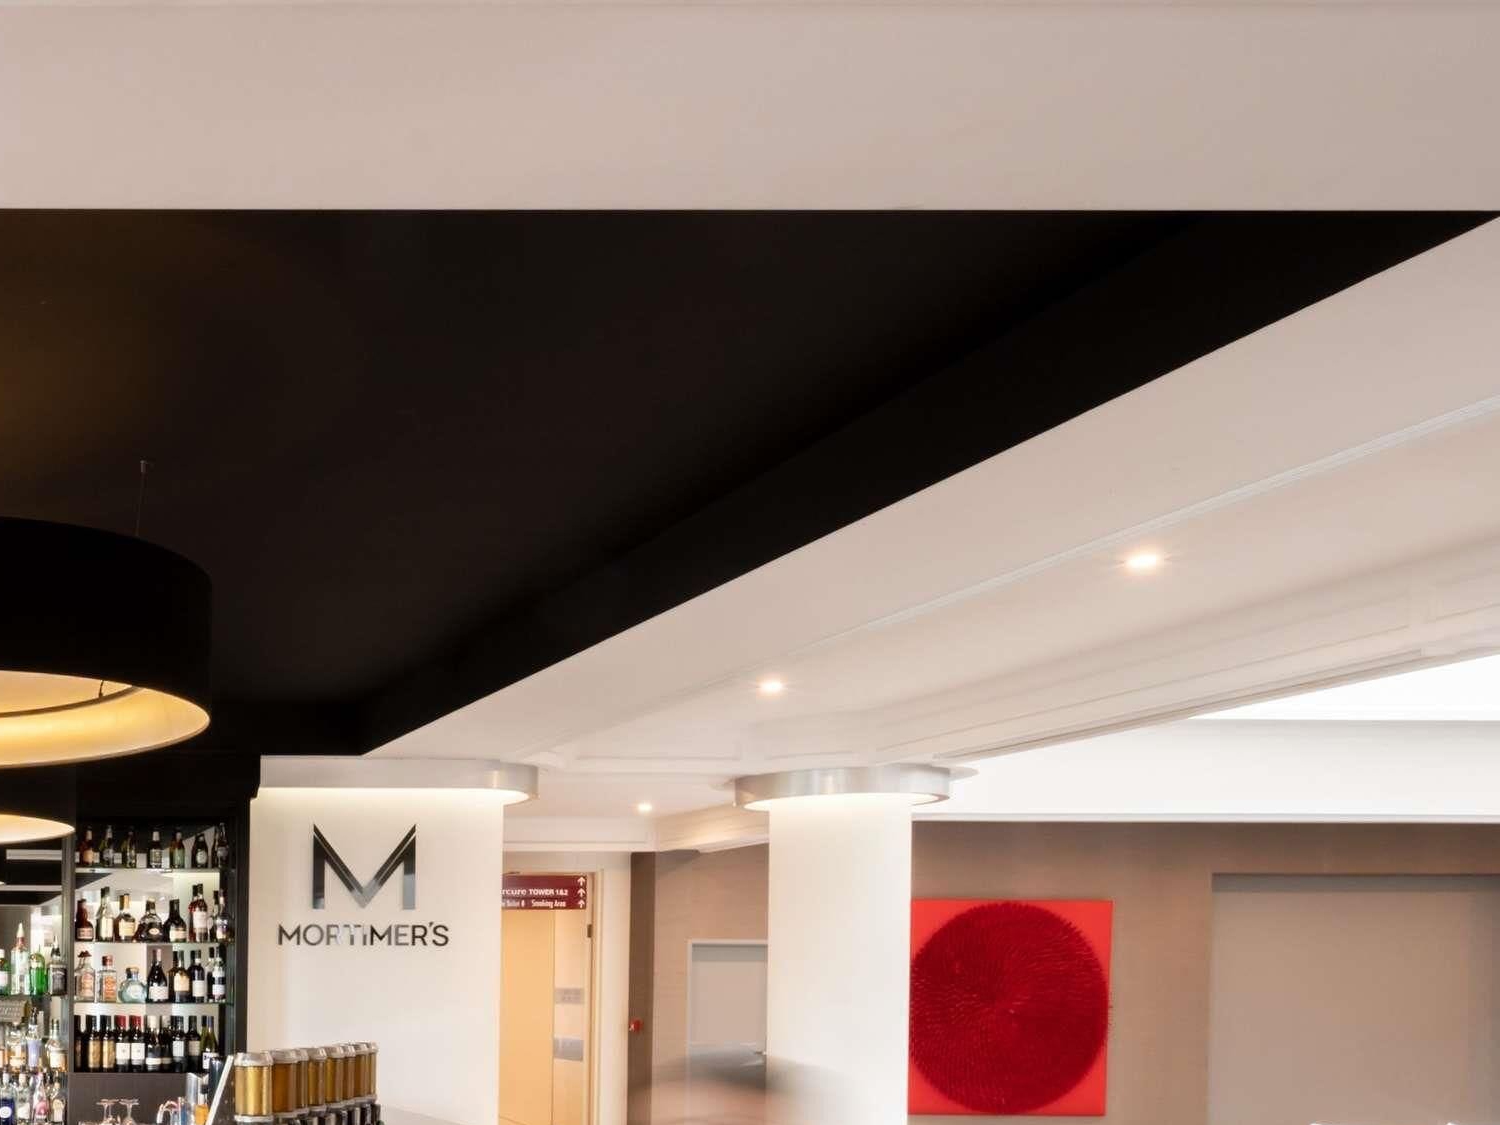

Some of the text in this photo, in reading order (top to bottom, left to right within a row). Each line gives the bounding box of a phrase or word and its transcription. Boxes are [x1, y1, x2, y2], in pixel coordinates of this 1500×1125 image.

[312, 824, 416, 909] M
[500, 888, 526, 896] rcure
[528, 888, 554, 896] TOWER
[278, 921, 449, 947] MORTIMER'S
